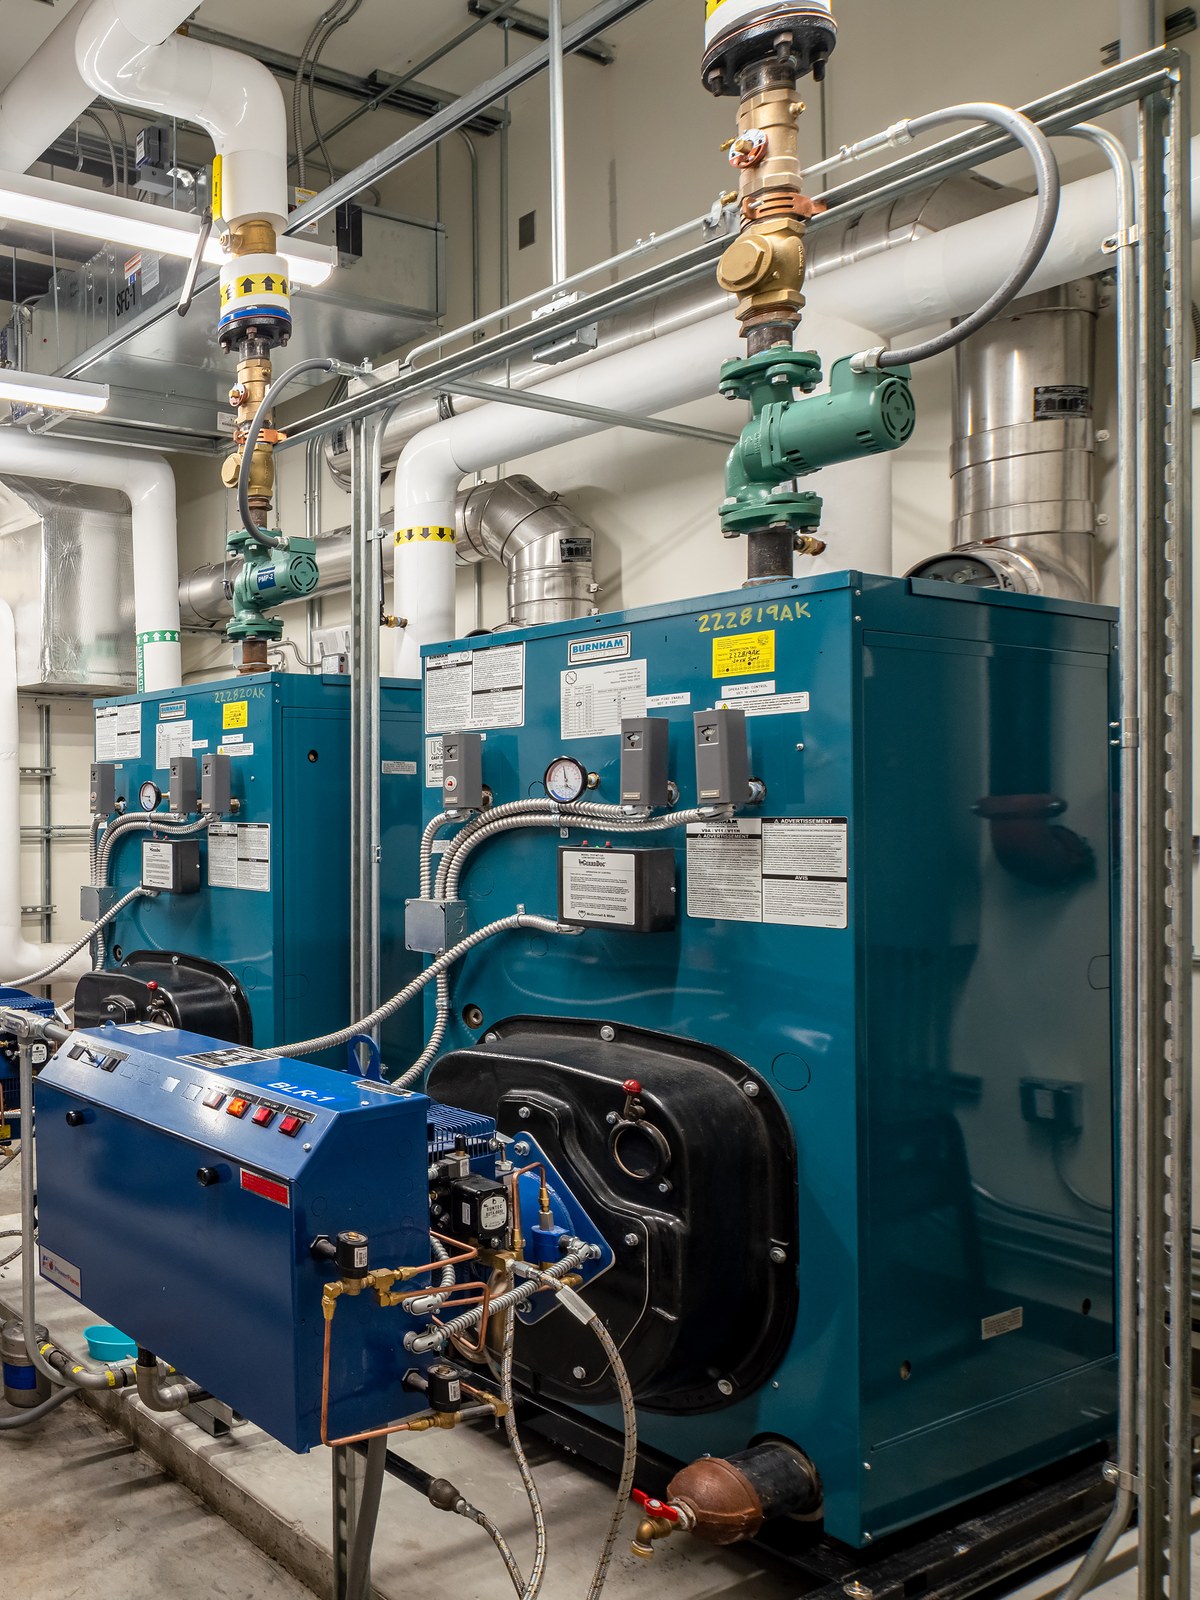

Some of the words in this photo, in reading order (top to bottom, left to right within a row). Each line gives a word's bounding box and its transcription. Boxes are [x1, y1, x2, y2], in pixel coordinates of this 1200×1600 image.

[116, 284, 136, 317] SFC-1
[257, 573, 275, 583] PMP-2
[698, 601, 811, 633] 222819AK
[572, 639, 624, 654] BURNHAM
[214, 687, 266, 703] 222820AK
[267, 1082, 336, 1102] BLR-1
